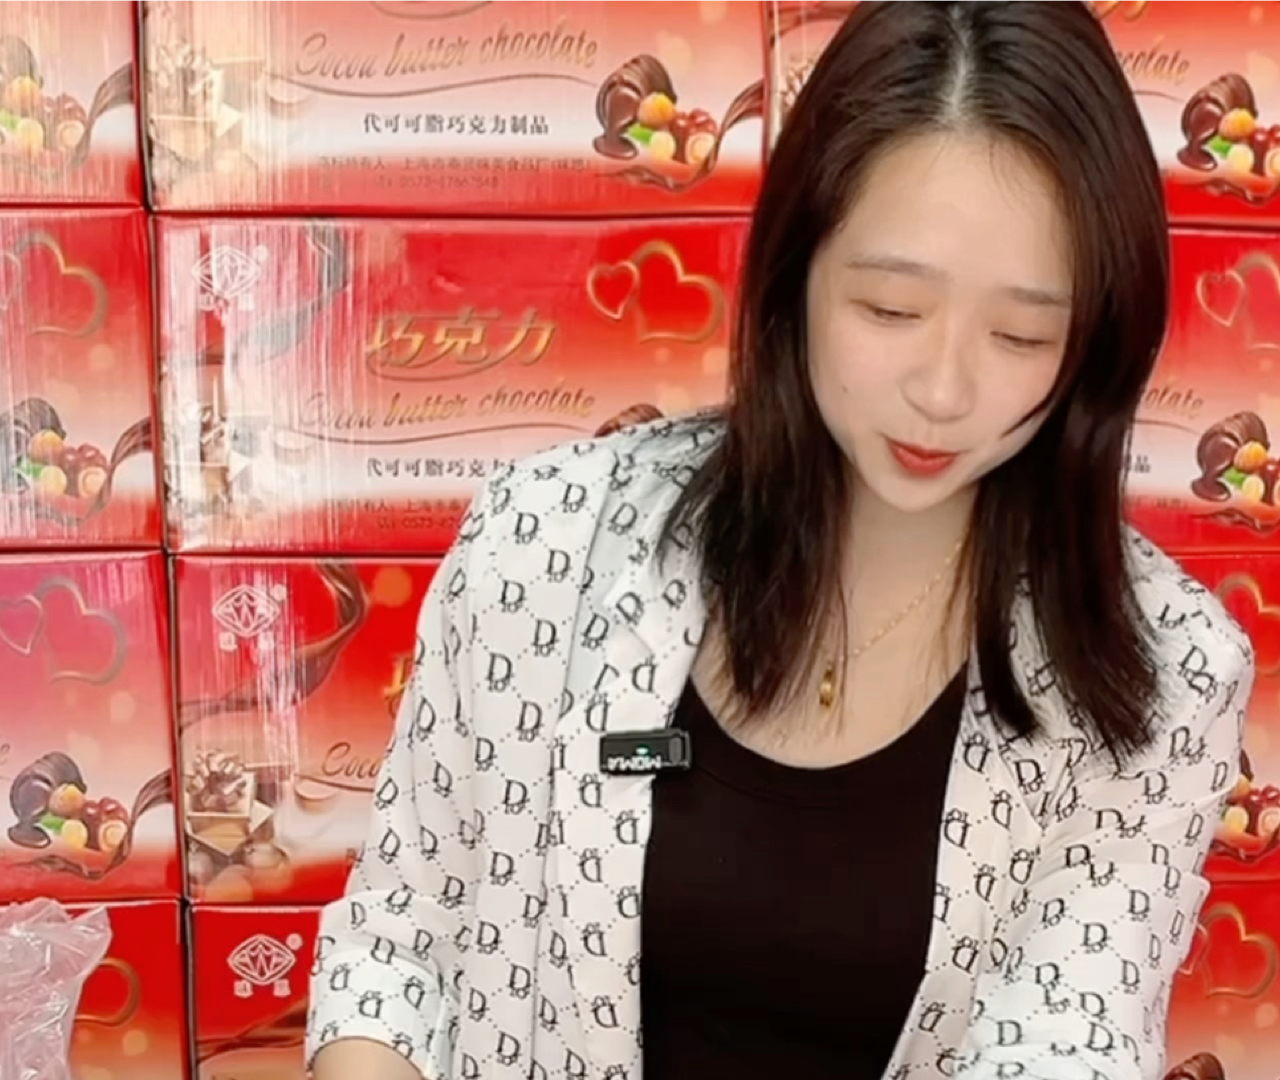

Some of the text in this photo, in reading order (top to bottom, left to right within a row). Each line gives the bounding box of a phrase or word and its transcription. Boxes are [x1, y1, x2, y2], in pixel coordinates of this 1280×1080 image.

[295, 24, 598, 79] Cocoa butter chocolate
[363, 113, 549, 136] 代可可脂巧克力制品
[366, 305, 559, 366] 巧克力
[384, 392, 469, 428] butter
[476, 380, 595, 420] chocolate
[322, 741, 381, 778] Coco
